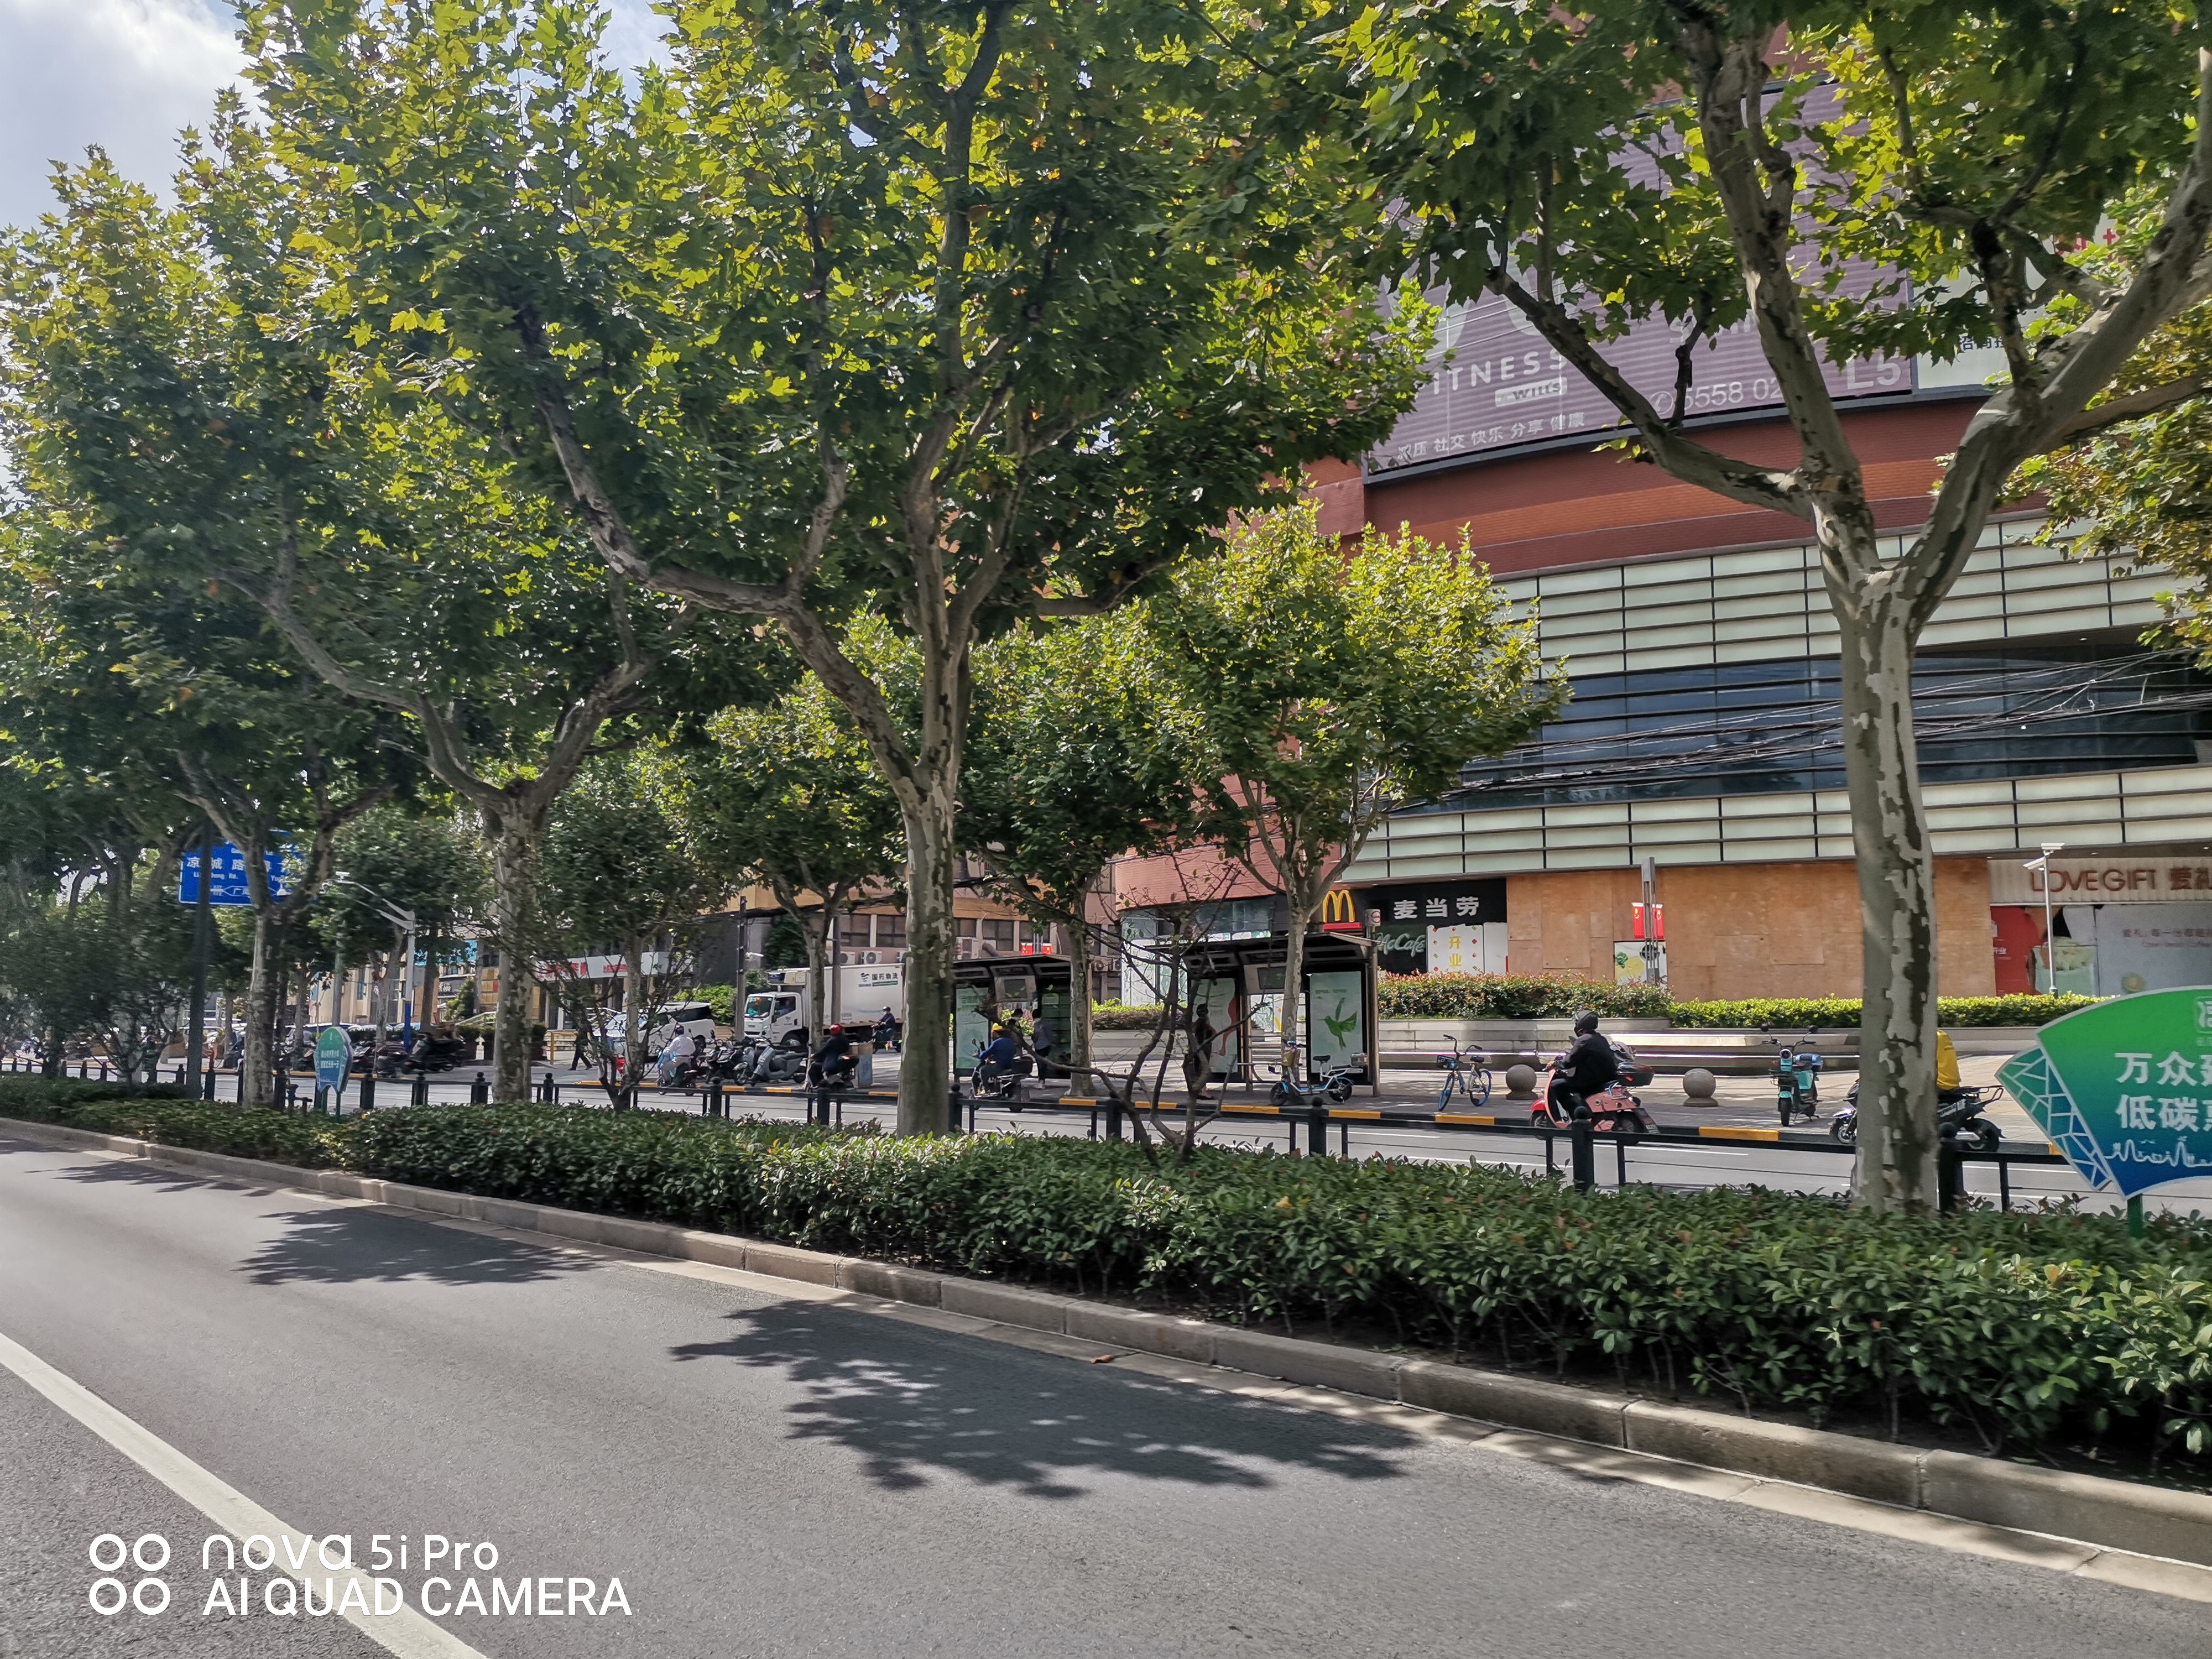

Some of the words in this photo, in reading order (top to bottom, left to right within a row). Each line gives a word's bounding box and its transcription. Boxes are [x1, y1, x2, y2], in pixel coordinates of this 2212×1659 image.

[1433, 347, 1567, 395] ITNESS
[1846, 346, 1901, 389] L5
[1754, 377, 1784, 400] 02
[1434, 434, 1466, 453] 社交
[1472, 425, 1504, 446] 快乐
[1510, 419, 1544, 440] 分享
[1550, 411, 1585, 432] 健康
[1394, 896, 1479, 920] 麦当劳
[1449, 936, 1462, 970] 开业
